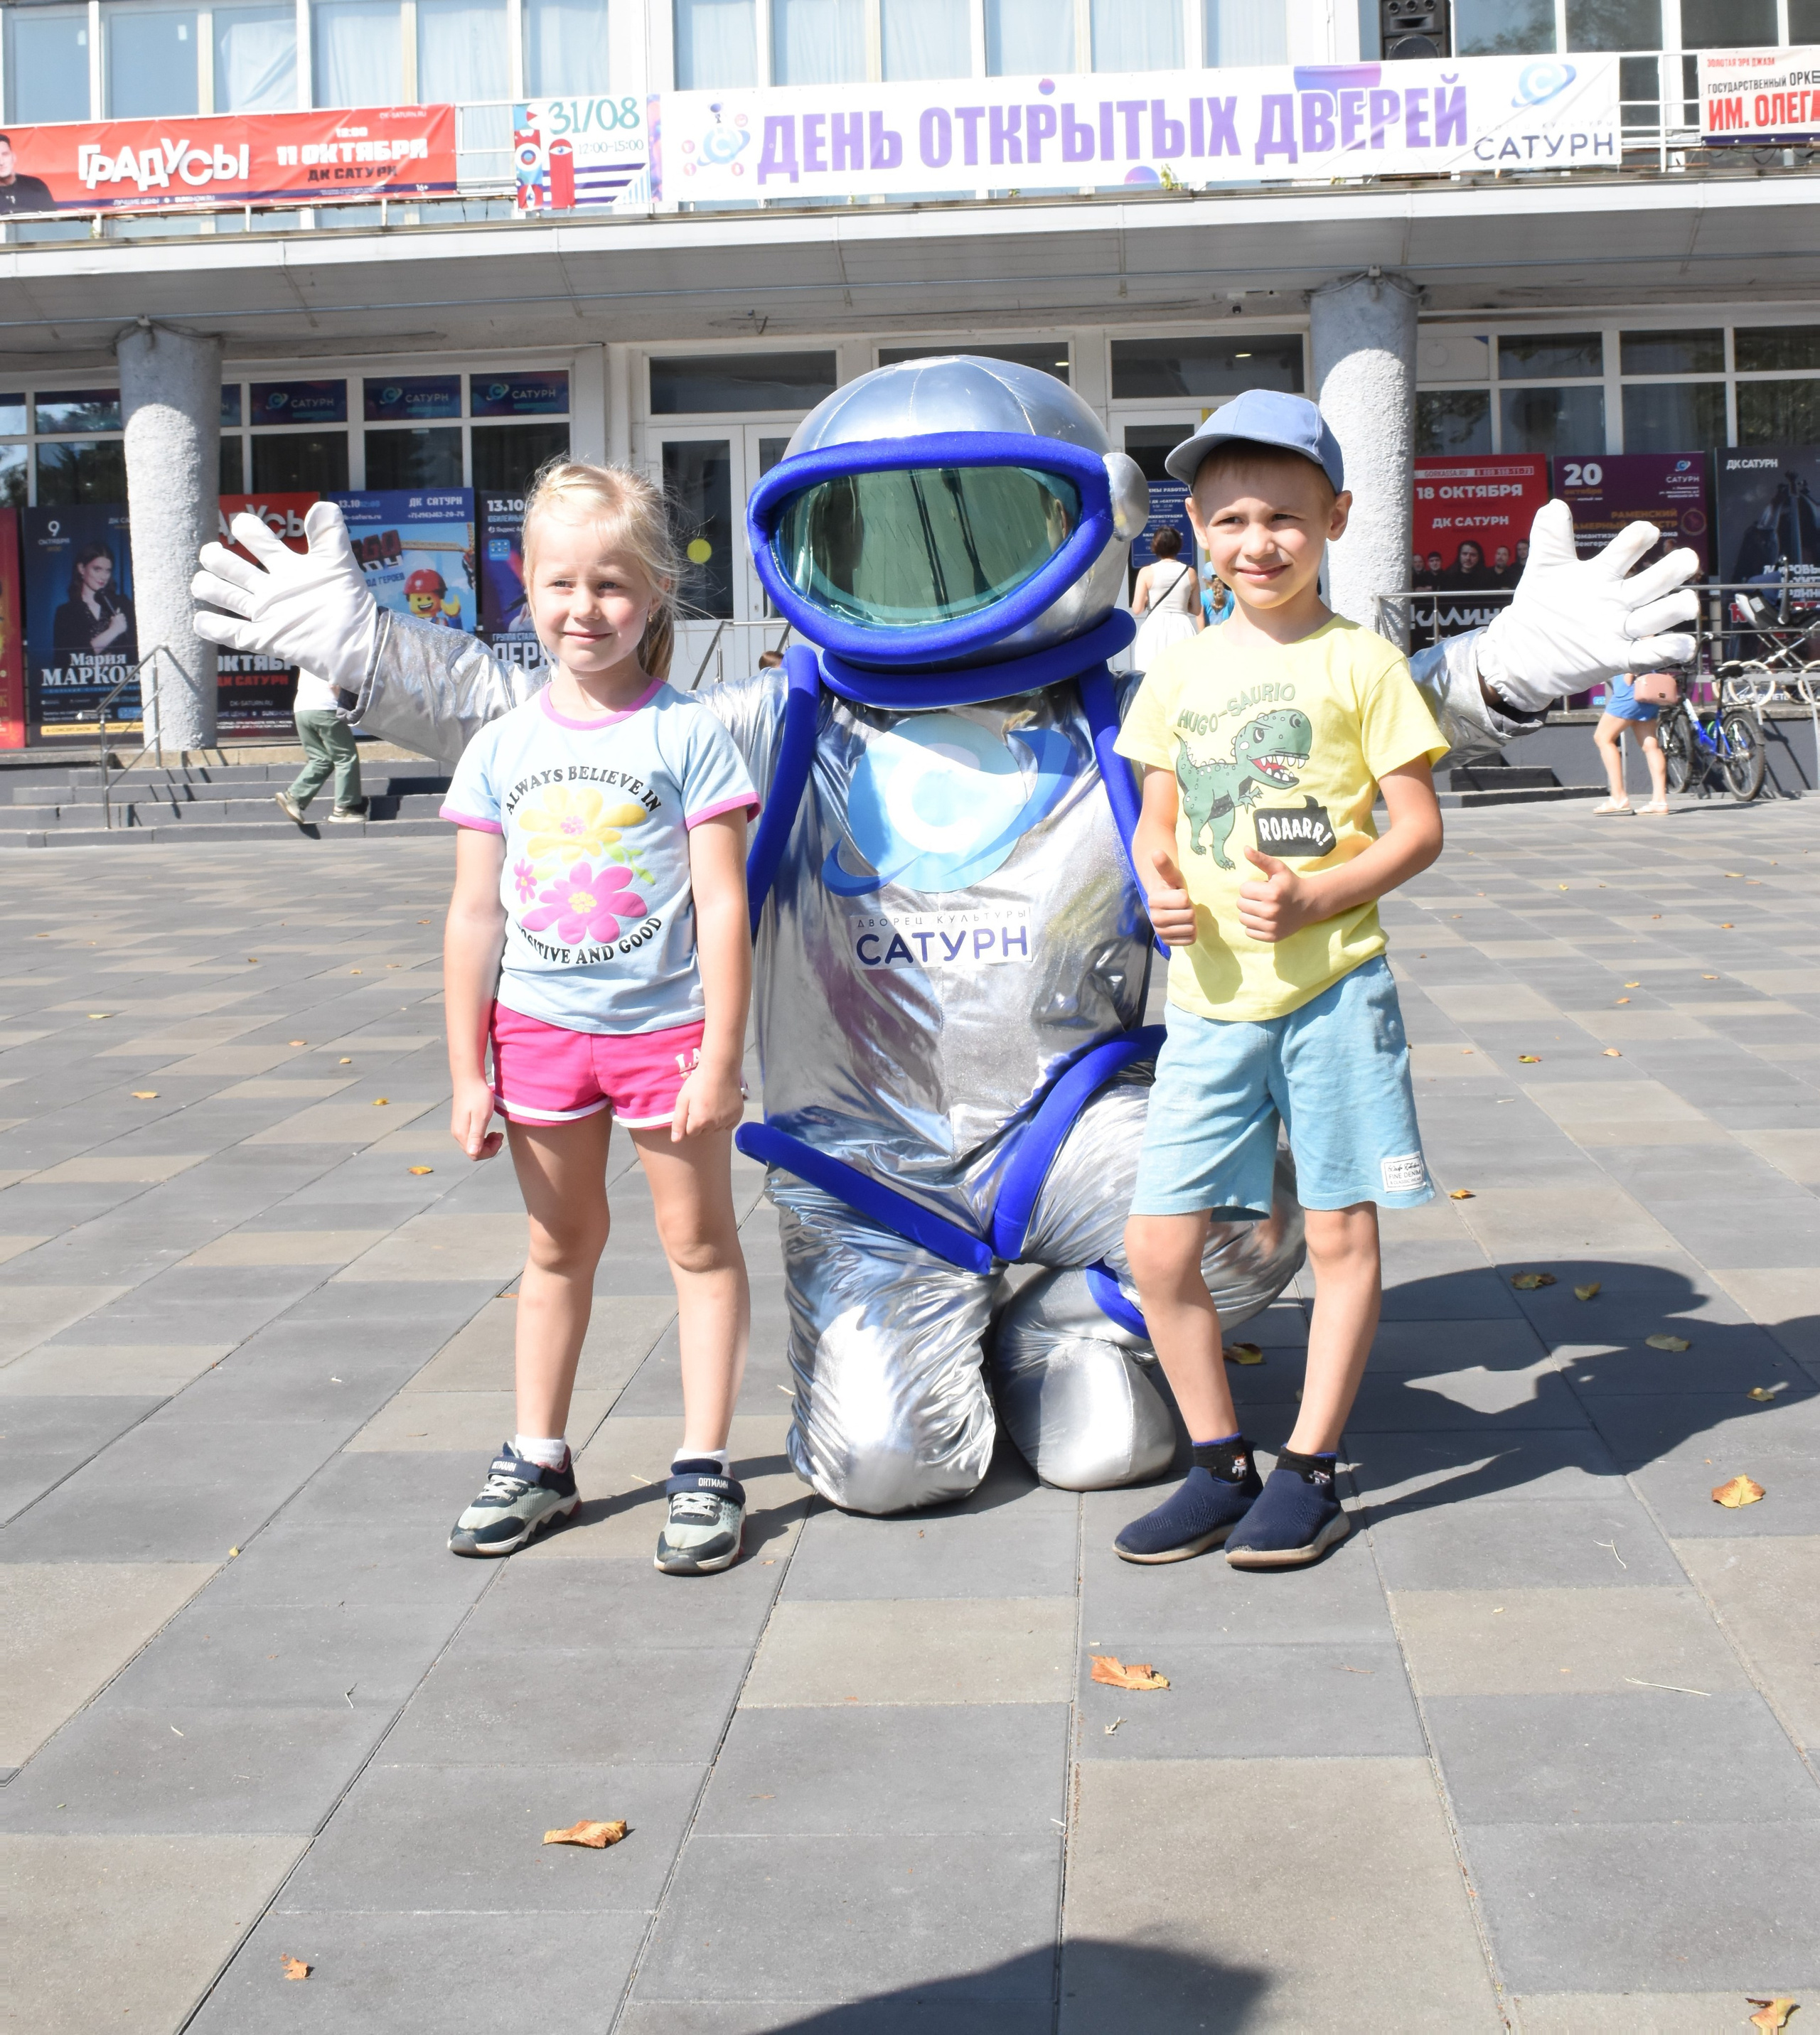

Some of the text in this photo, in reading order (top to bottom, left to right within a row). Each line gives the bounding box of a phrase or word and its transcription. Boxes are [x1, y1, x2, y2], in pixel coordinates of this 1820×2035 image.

[1707, 57, 1776, 68] ЗОЛОТАЯ ЭРА ДЖАЗА
[1708, 75, 1787, 94] ГОСУДАРСТВЕННЫЙ
[548, 97, 641, 135] 31/08
[1709, 97, 1750, 132] ИМ.
[757, 73, 1467, 185] ДЕНЬ ОТКРЫТЫХ ДВЕРЕЙ
[277, 138, 428, 166] 11 ОКТЯБРЯ
[1474, 132, 1613, 161] САТУРН
[78, 138, 250, 192] ГРАДУСЫ
[308, 166, 397, 183] ДК САТУРН
[416, 183, 429, 192] 16+
[405, 394, 449, 403] САТУРН
[512, 389, 557, 399] САТУРН
[291, 398, 335, 408] САТУРН
[1726, 458, 1778, 470] ДК САТУРН
[1563, 463, 1602, 485] 20
[1416, 484, 1523, 500] 18 ОКТЯБРЯ
[409, 496, 463, 508] ДК САТУРН
[487, 499, 524, 512] 13.10
[1611, 508, 1678, 519] РАМЕНСКИЙ
[48, 520, 60, 537] 9
[1432, 515, 1509, 529] ДК САТУРН
[378, 572, 405, 585] ГЕРОЕВ
[493, 633, 516, 641] ГРУППА
[70, 653, 127, 668] Мария
[235, 675, 289, 686] САТУРН
[1177, 682, 1296, 736] HUGO-SAURIO
[505, 766, 662, 815] ALWAYS BELIEVE IN
[1258, 817, 1333, 846] ROAARR!
[857, 910, 1026, 928] ДВОРЕЦ КУЛЬТУРЫ
[575, 945, 614, 965] AND
[619, 917, 662, 954] GOOD
[856, 925, 1028, 965] САТУРН
[1403, 1169, 1421, 1178] DENIM
[698, 1477, 729, 1489] ORTMANN
